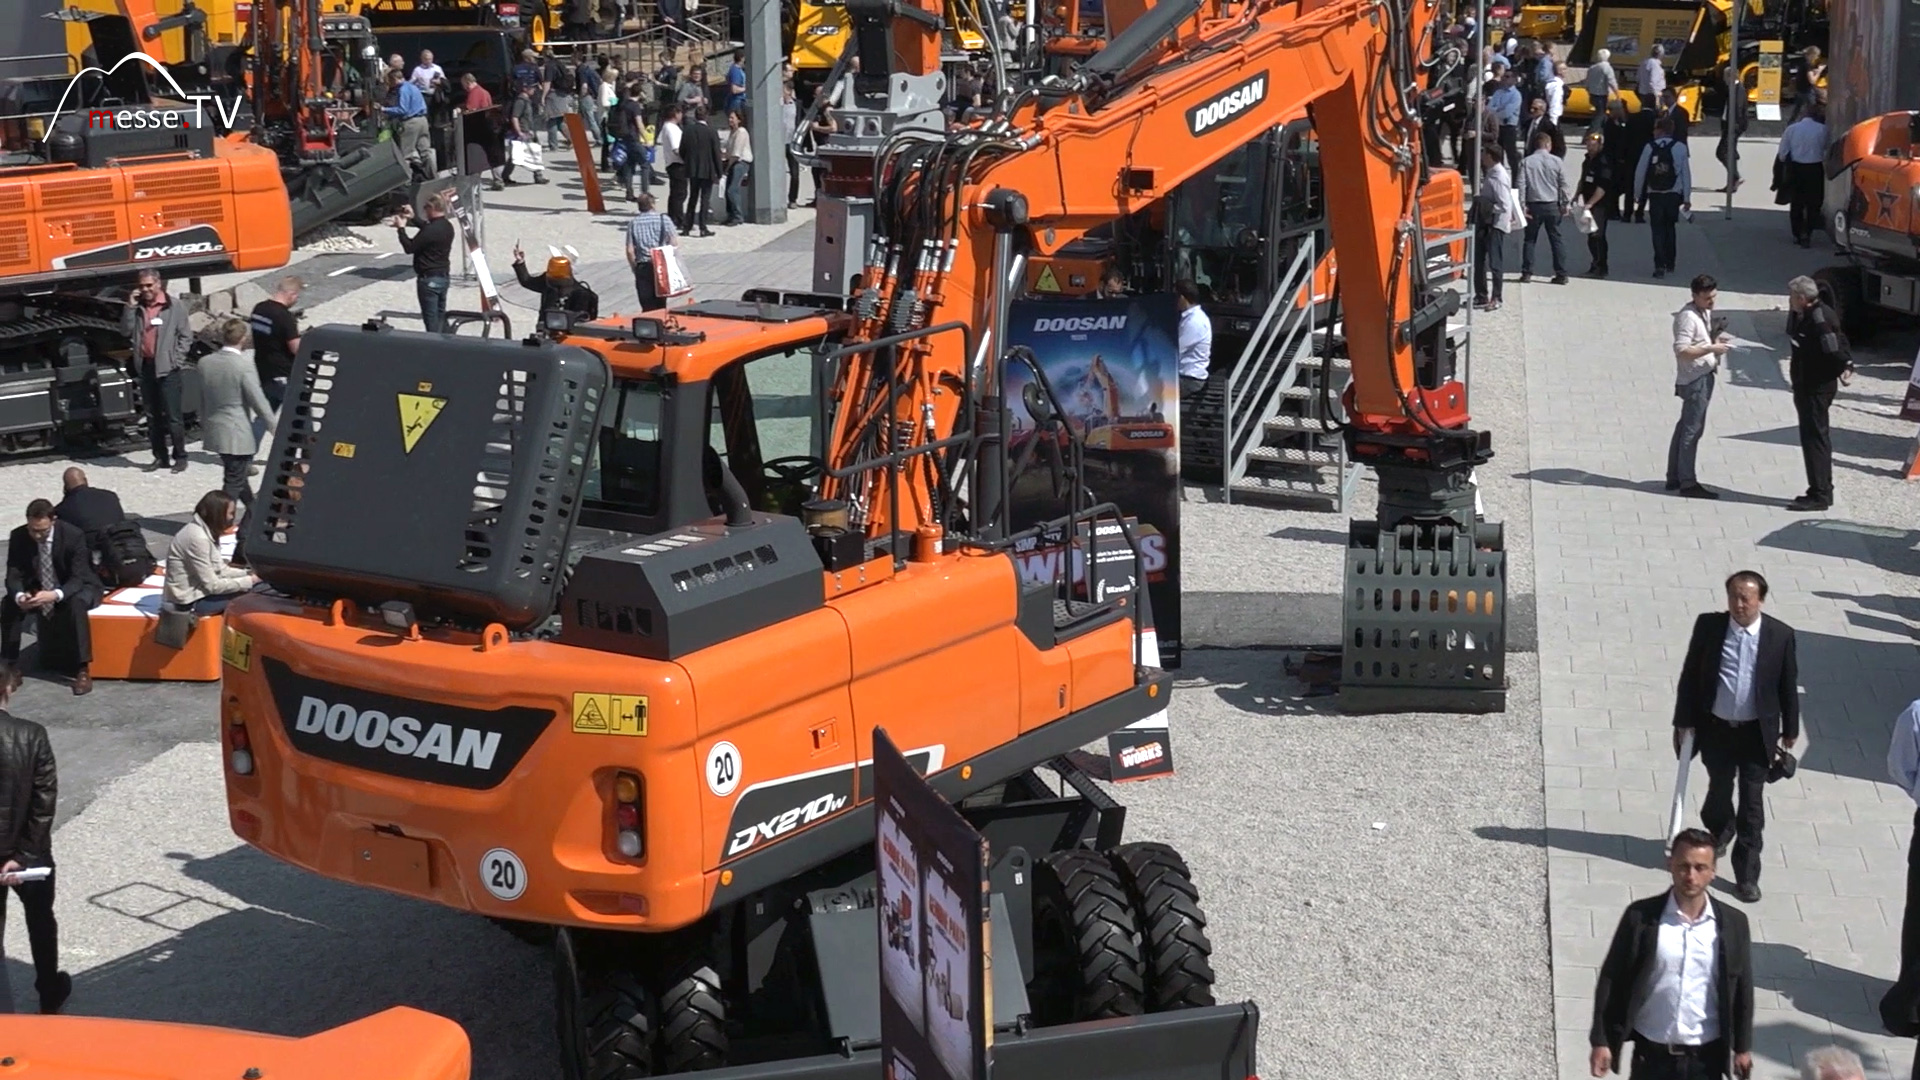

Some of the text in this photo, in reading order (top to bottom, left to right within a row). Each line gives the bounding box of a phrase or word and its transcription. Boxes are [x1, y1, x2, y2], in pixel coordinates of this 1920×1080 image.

[808, 26, 840, 35] JCB
[1194, 78, 1264, 133] DOOSAN
[1033, 314, 1127, 333] DOOSAN
[1129, 429, 1165, 440] DOOSAN
[295, 694, 502, 771] DOOSAN
[715, 751, 734, 785] 20
[1122, 744, 1164, 768] WORKS
[491, 859, 516, 890] 20
